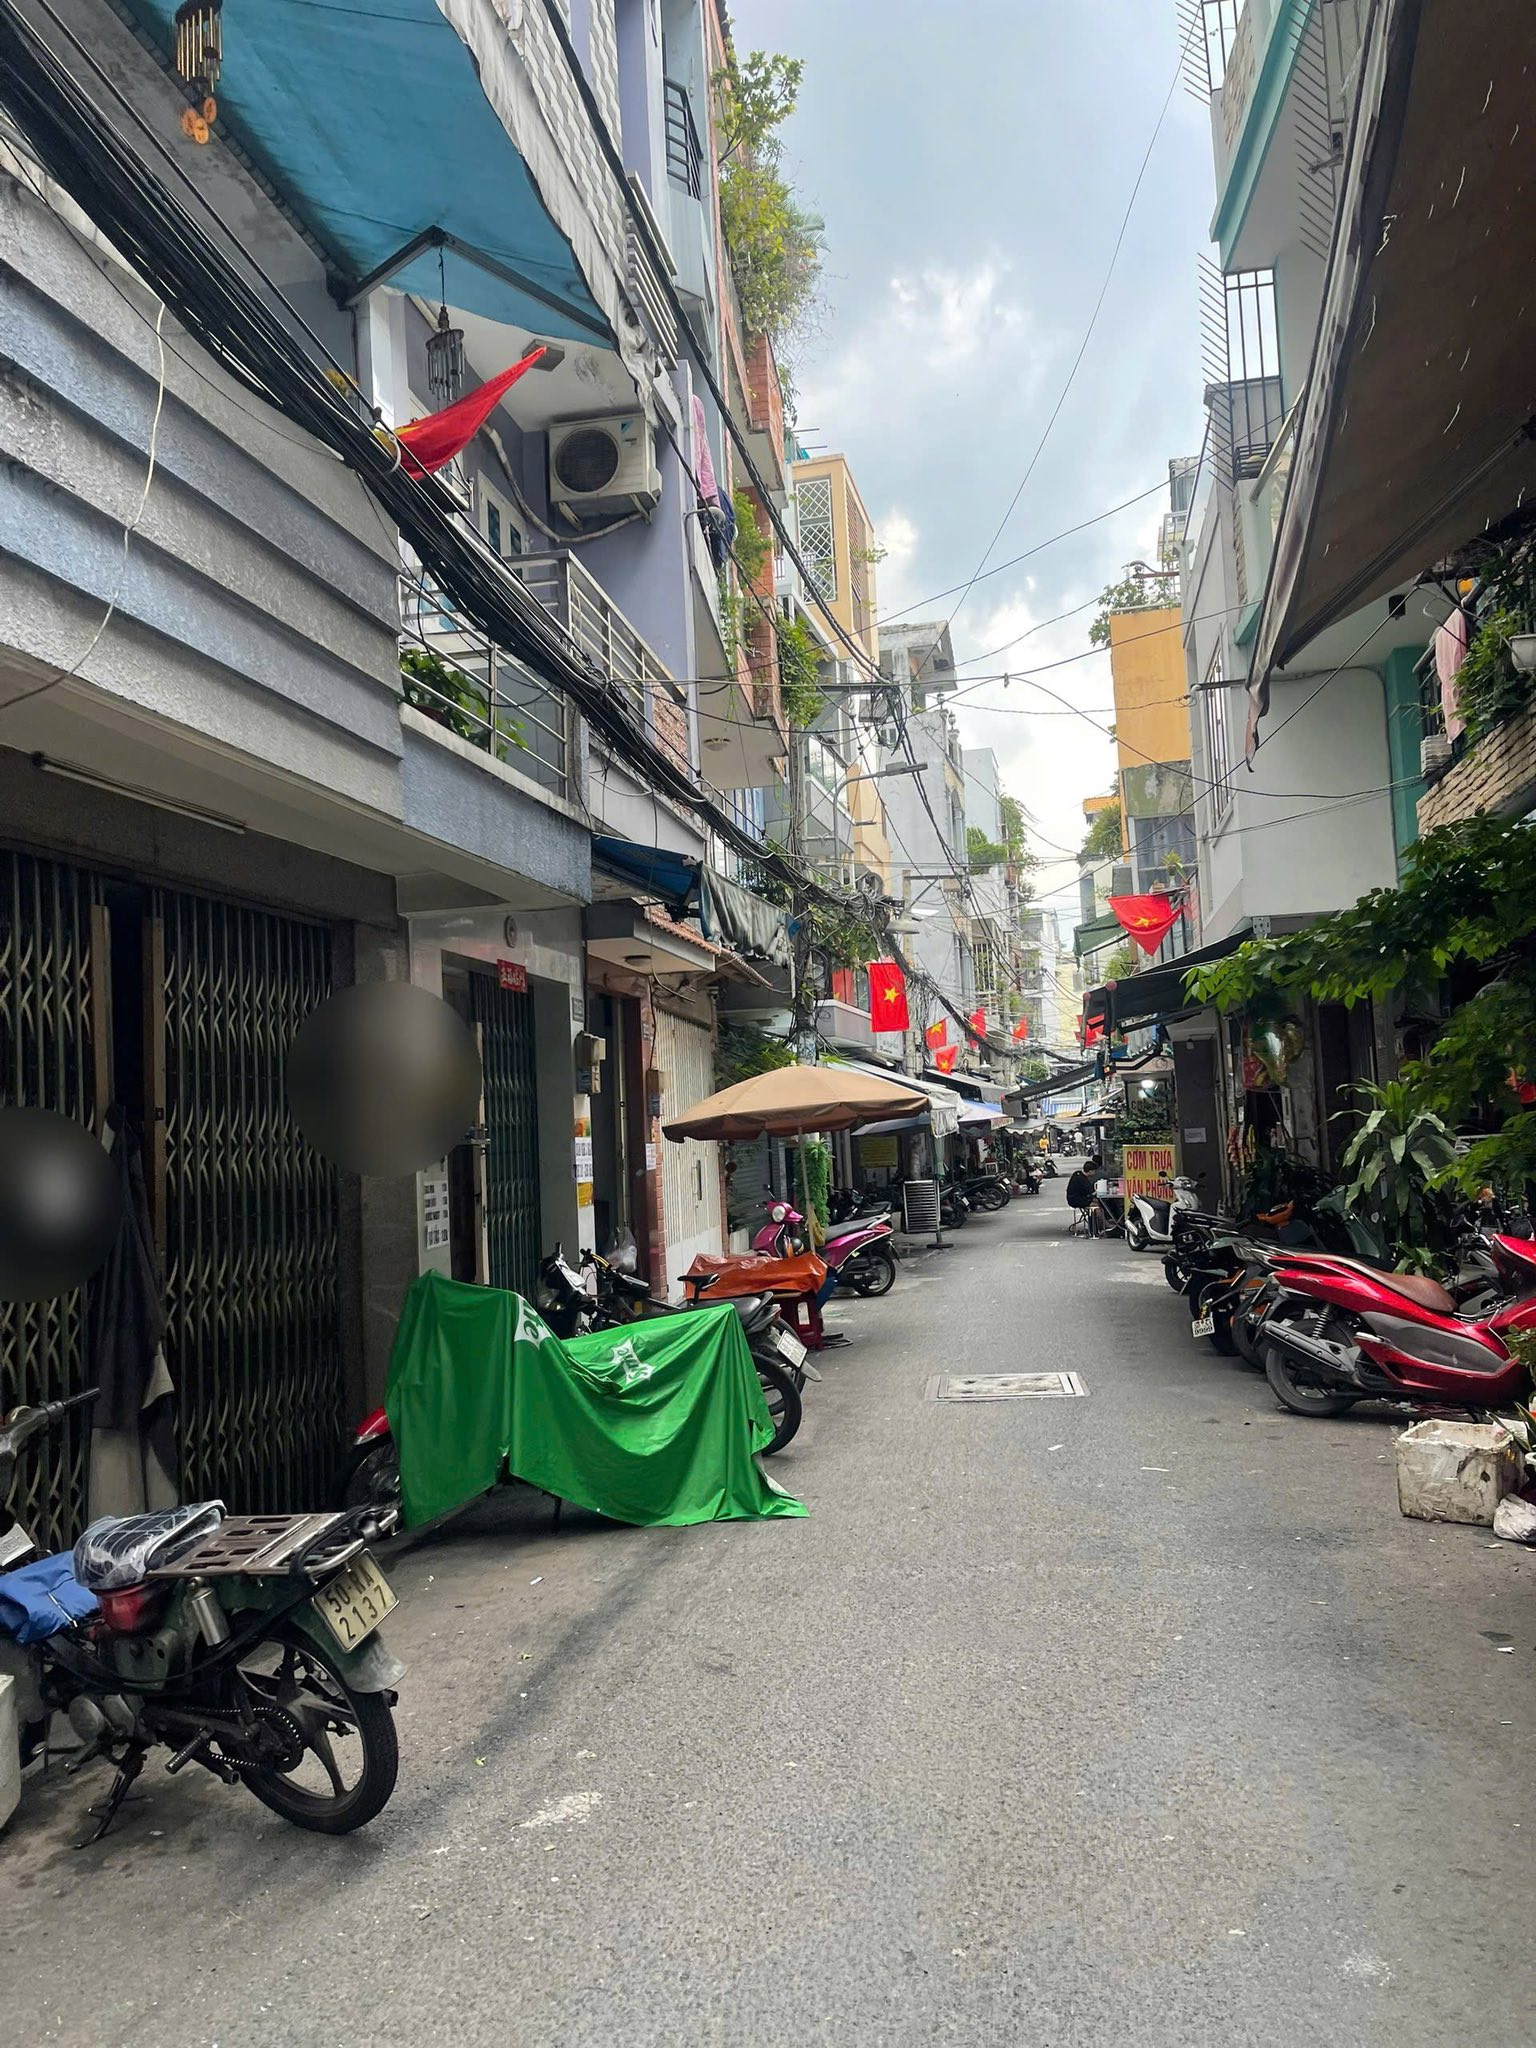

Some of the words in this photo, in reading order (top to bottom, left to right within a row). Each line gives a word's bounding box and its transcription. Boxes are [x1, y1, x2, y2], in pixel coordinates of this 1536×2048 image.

[1127, 1149, 1146, 1170] CƠM
[1149, 1149, 1172, 1170] TRƯA
[339, 1584, 388, 1642] 2137
